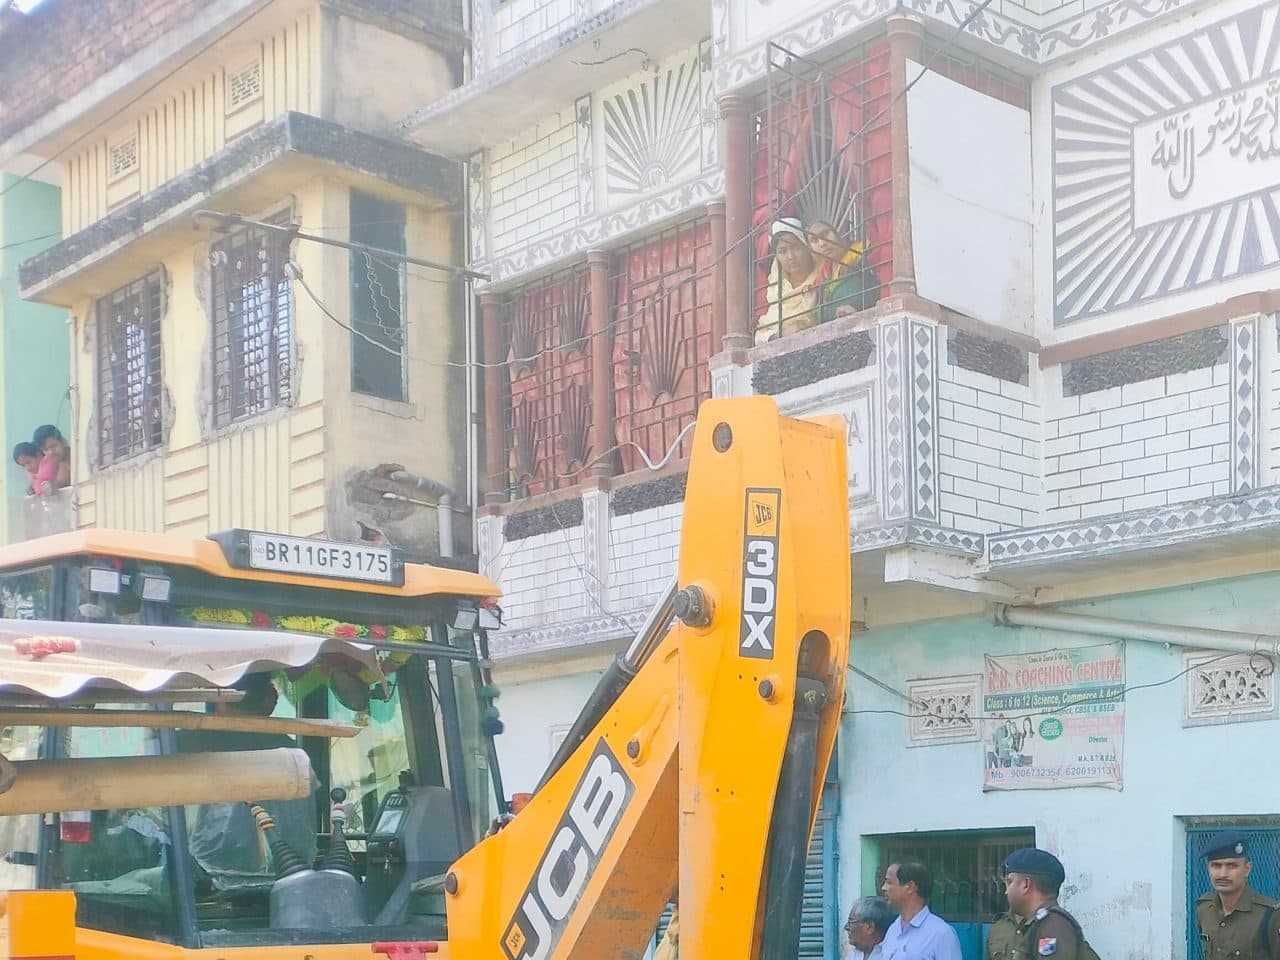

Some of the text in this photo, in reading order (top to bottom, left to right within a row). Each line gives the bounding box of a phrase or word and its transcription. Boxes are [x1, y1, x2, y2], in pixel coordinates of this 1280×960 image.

[756, 503, 773, 525] JCB
[265, 541, 388, 573] BR11GF3175
[741, 540, 775, 651] 3DX
[1016, 663, 1073, 688] COACHING
[1077, 657, 1122, 681] CENTRE
[1062, 690, 1097, 704] Commerce
